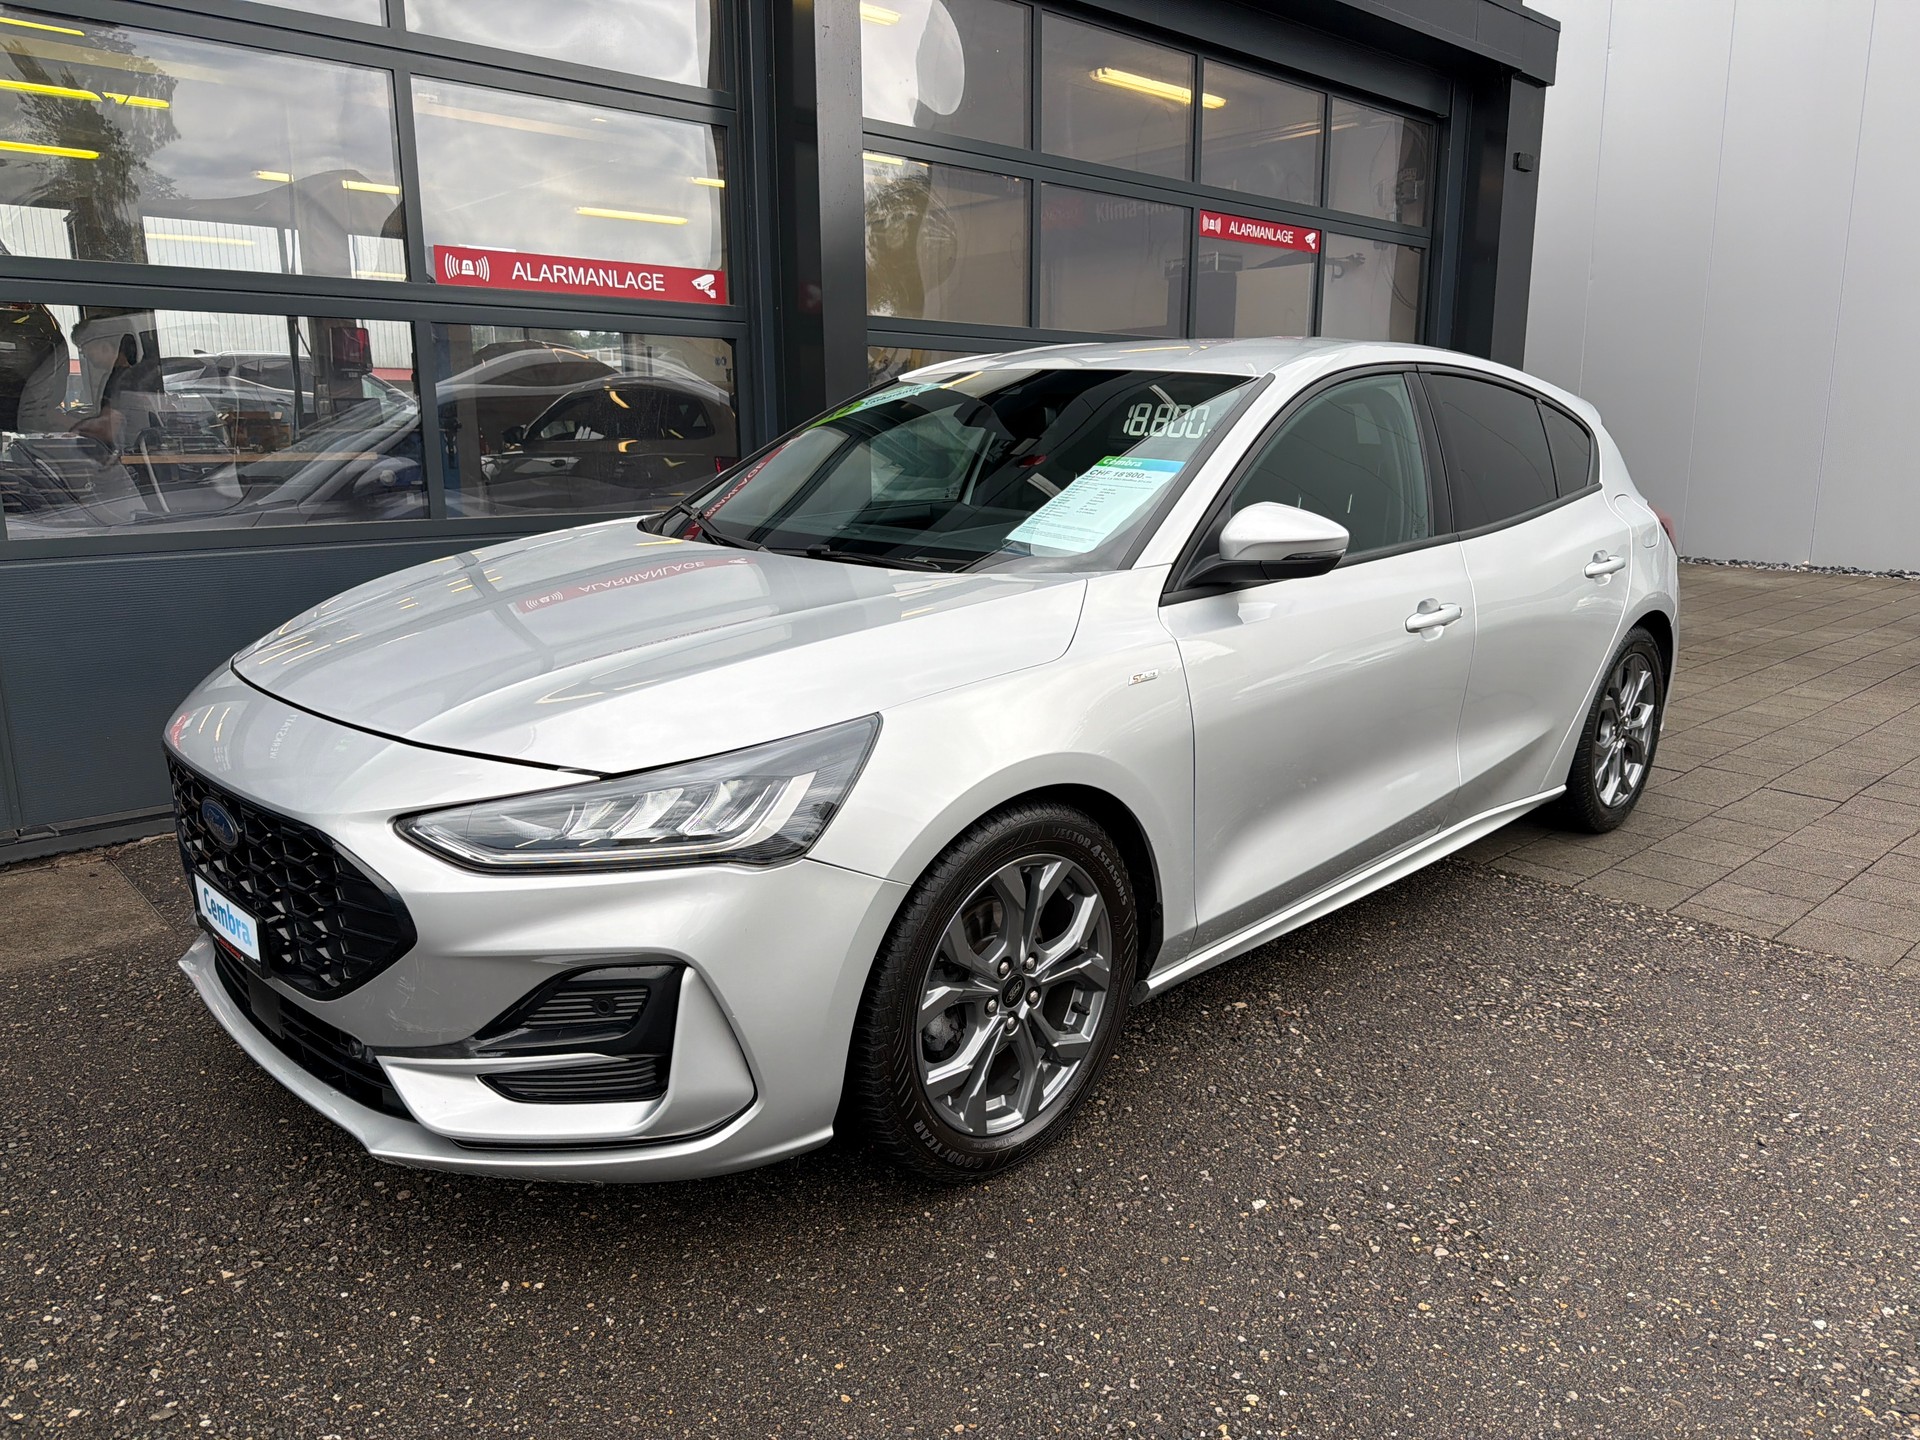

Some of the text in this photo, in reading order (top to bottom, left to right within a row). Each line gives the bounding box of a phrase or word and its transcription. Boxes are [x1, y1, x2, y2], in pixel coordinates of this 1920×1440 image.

[1229, 221, 1294, 244] ALARMANLAGE
[512, 261, 666, 292] ALARMANLAGE
[1103, 458, 1143, 467] Cembra
[1053, 827, 1092, 848] VECTOR
[204, 887, 252, 947] Cembra
